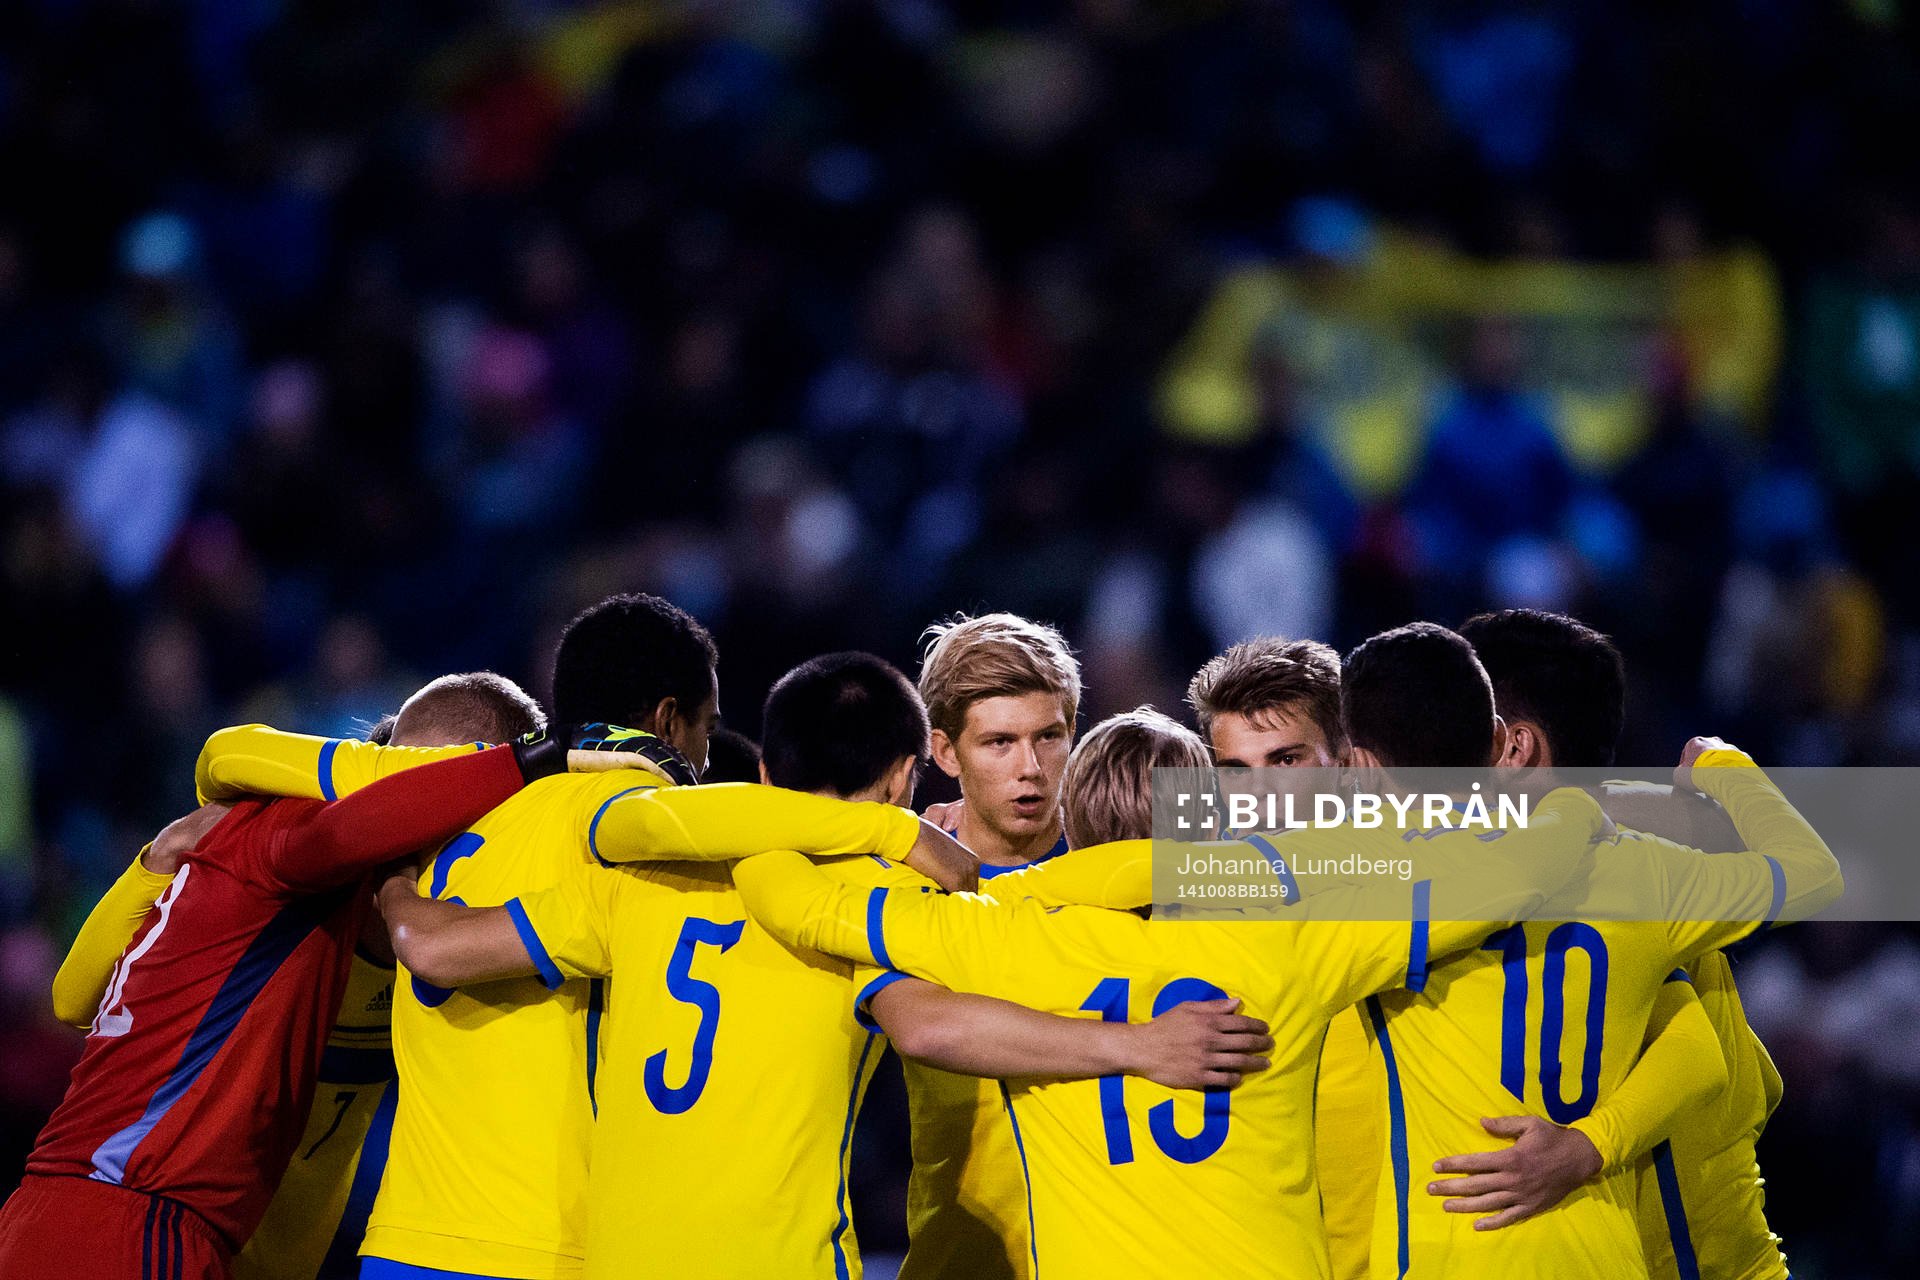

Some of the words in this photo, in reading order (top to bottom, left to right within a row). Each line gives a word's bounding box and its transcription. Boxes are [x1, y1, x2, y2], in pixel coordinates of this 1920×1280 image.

[643, 916, 747, 1115] 5
[1479, 920, 1609, 1126] 10
[303, 1091, 358, 1161] 7
